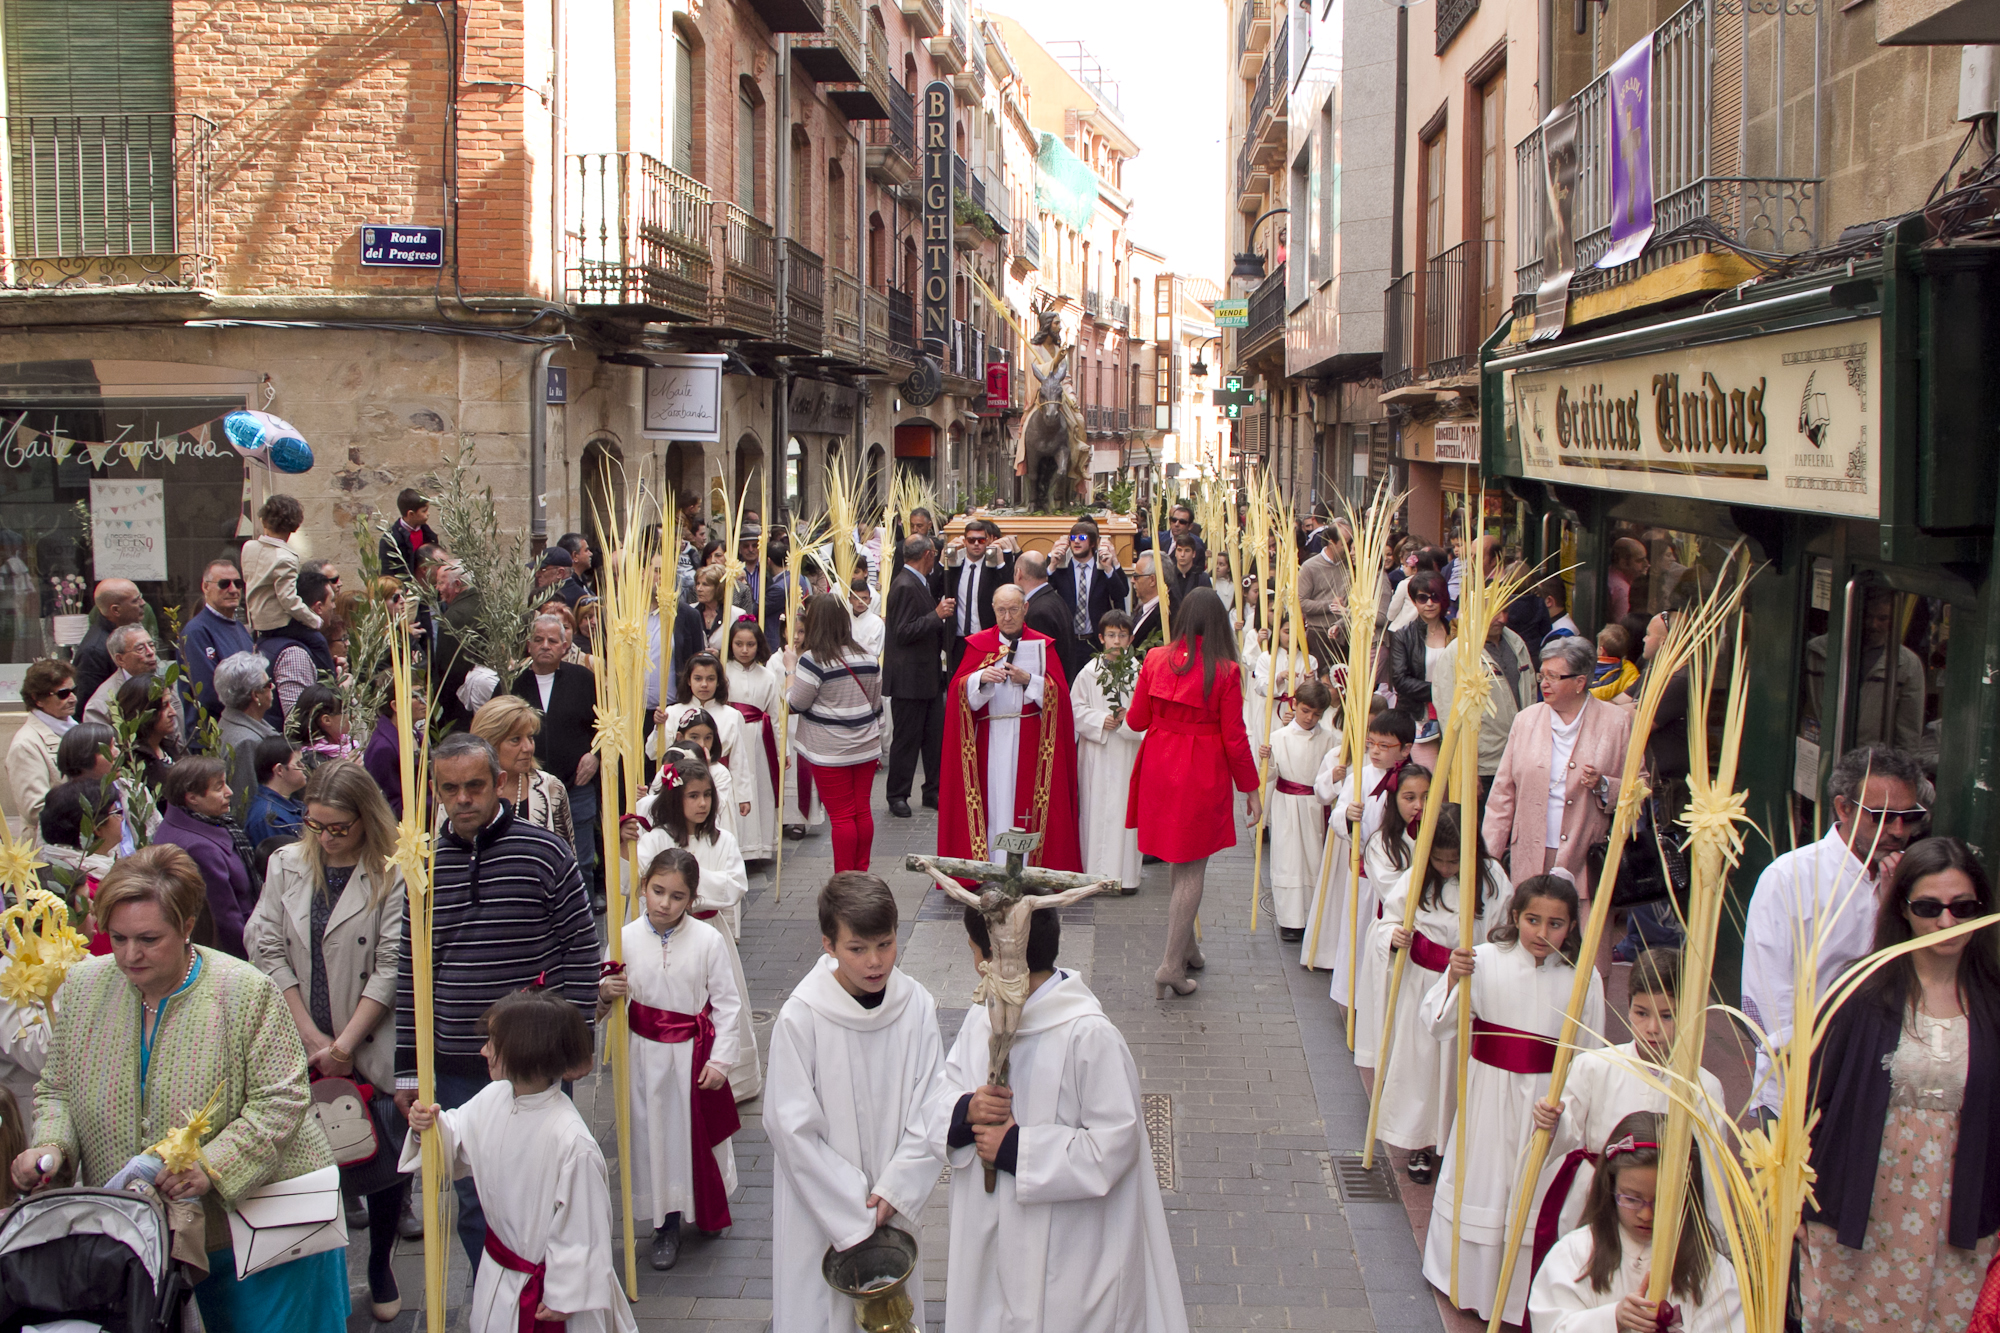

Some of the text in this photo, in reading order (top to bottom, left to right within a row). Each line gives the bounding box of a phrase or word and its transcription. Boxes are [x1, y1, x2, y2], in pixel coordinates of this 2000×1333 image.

[925, 91, 947, 332] BRIGHTON
[390, 231, 427, 244] Ronda
[365, 247, 438, 262] del Progreso
[1219, 309, 1243, 317] VENDE
[651, 377, 693, 400] Maite
[1555, 371, 1767, 454] Gráficas Unidas
[77, 421, 234, 467] Zarabanda
[1794, 453, 1834, 468] PAPELERIA
